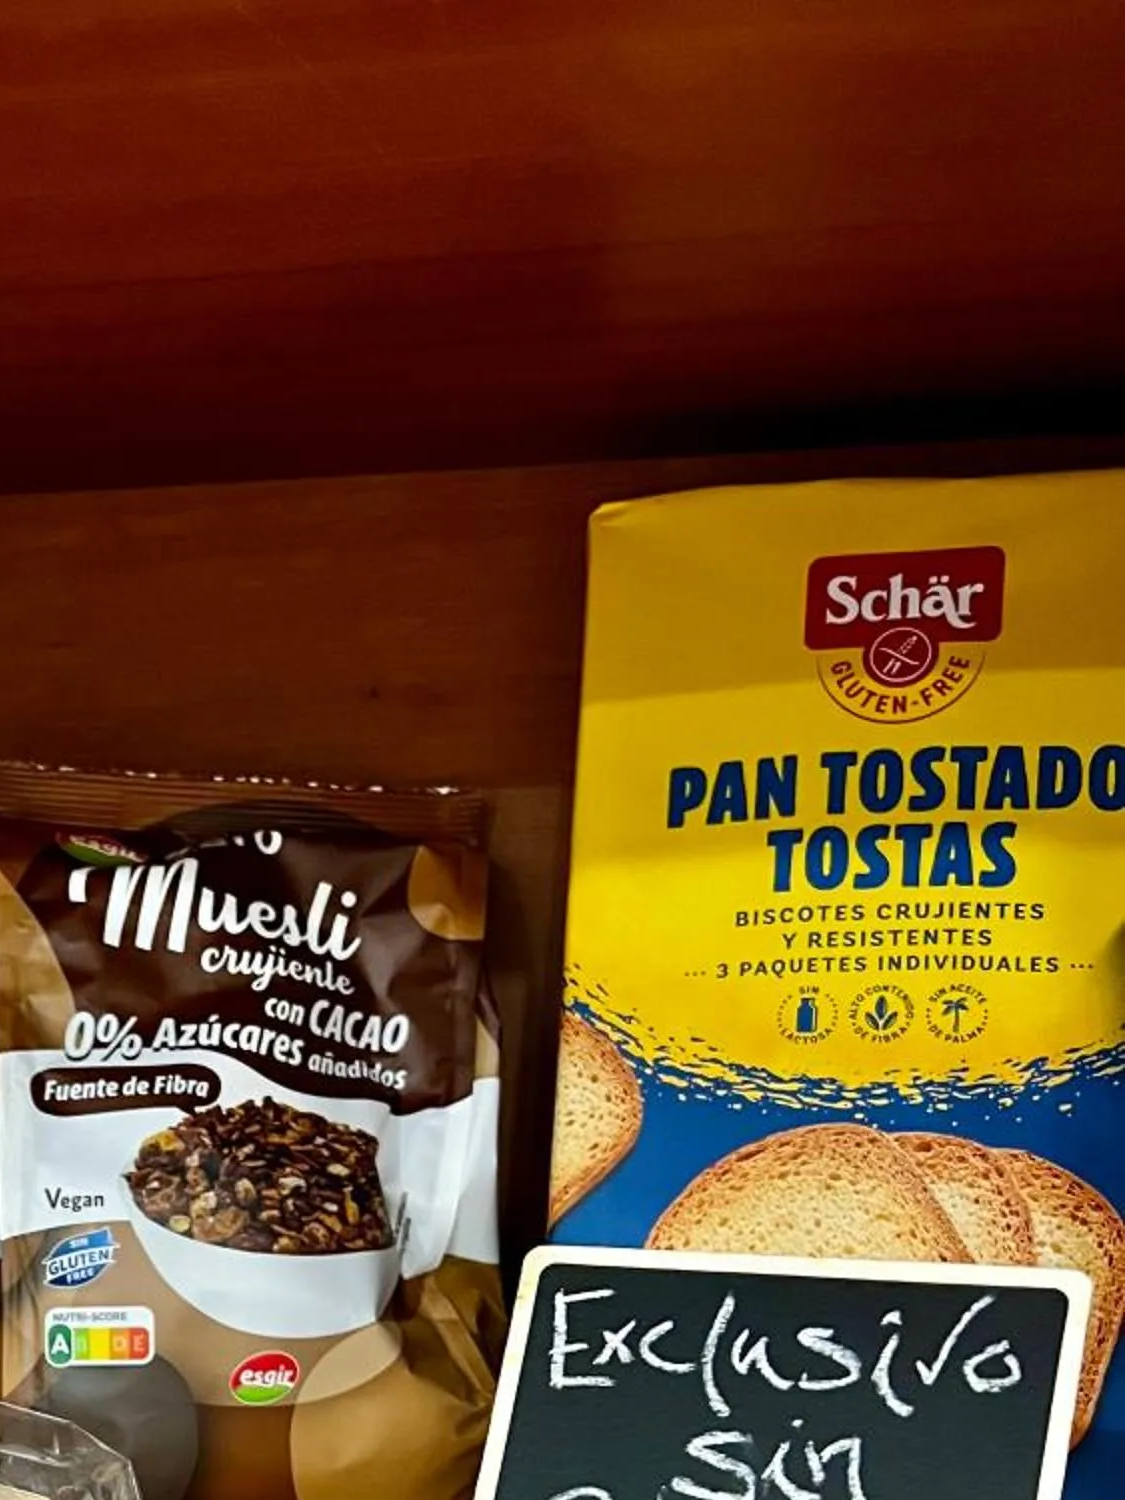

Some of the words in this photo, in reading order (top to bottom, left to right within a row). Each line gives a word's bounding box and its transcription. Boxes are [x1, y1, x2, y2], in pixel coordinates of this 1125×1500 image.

[825, 572, 984, 629] Schär
[829, 654, 972, 715] GLUTEN-FREE
[667, 754, 799, 829] PAN
[820, 744, 1125, 815] TOSTADO
[767, 820, 1017, 893] TOSTAS
[68, 857, 362, 961] Muesli
[735, 904, 865, 927] BISCOTES
[876, 902, 1045, 922] CRUJIENTES
[781, 932, 799, 949] Y
[808, 929, 993, 949] RESISTENTES
[200, 944, 356, 996] crujiente
[715, 963, 729, 979] 3
[739, 956, 868, 979] PAQUETES
[877, 955, 1060, 973] INDIVIDUALES
[799, 985, 820, 995] SIN
[949, 983, 988, 1006] ACEITE
[264, 997, 305, 1028] con
[309, 1000, 410, 1054] CACAO
[780, 1027, 833, 1045] LACTOSA
[944, 1026, 986, 1044] PALMA
[63, 1011, 143, 1061] 0%
[151, 1015, 303, 1068] Azúcares
[307, 1052, 408, 1091] añadidos
[44, 1078, 119, 1102] Fuente
[121, 1075, 149, 1098] de
[154, 1075, 210, 1100] Fibra
[44, 1187, 105, 1213] Vegan
[48, 1249, 110, 1276] GLUTEN
[239, 1362, 296, 1386] esgir
